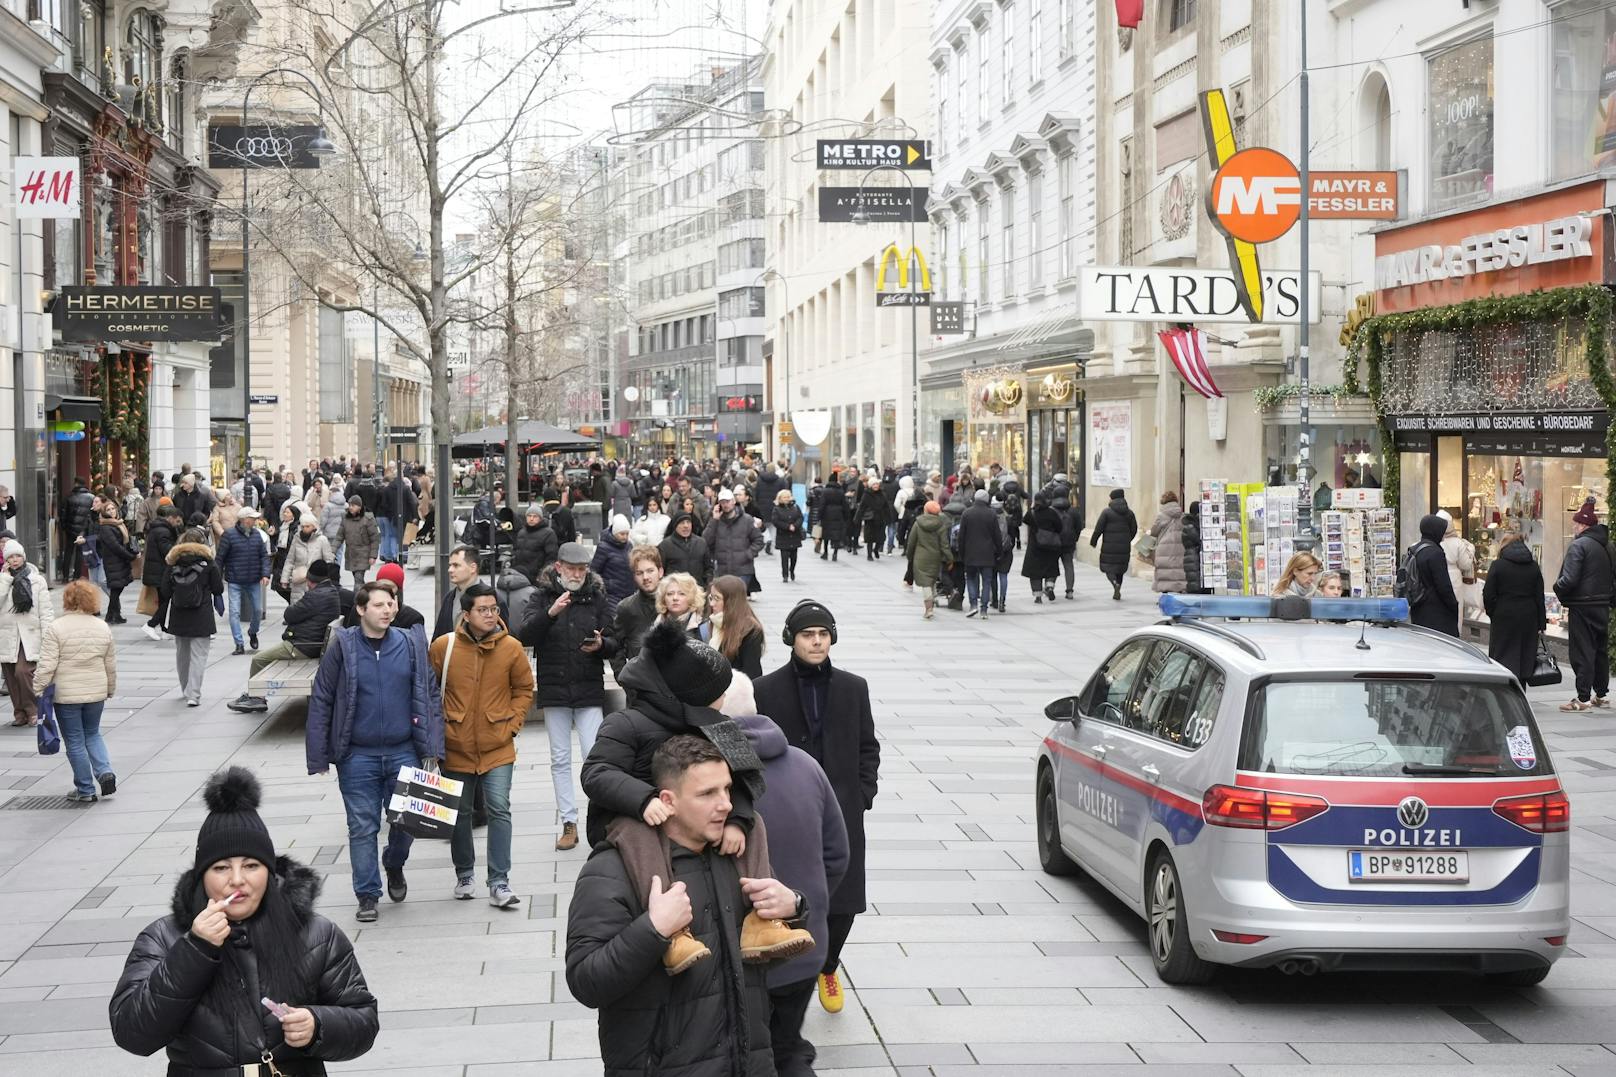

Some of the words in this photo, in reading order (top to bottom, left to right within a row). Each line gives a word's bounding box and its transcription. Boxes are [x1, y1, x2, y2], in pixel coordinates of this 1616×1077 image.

[1446, 94, 1479, 125] JOOP!
[824, 145, 901, 158] METRO
[20, 170, 73, 205] H&M
[1312, 179, 1371, 193] MAYR
[1374, 181, 1388, 193] &
[1217, 176, 1301, 215] MF
[1308, 198, 1395, 212] FESSLER
[67, 295, 213, 309] HERMETISE
[1096, 272, 1300, 318] TARD'S
[108, 324, 169, 333] COSMETIC
[1396, 418, 1425, 429] EXQUISITE
[1427, 417, 1475, 429] SCHREIBWAREN
[1477, 417, 1491, 429] UND
[1493, 416, 1536, 429] GESCHENKE
[1543, 414, 1593, 428] BÜROBEDARF
[1192, 717, 1213, 745] 133
[1078, 781, 1118, 827] POLIZEI
[1364, 828, 1461, 845] POLIZEI
[1370, 856, 1390, 874] BP
[1405, 856, 1458, 874] 91288
